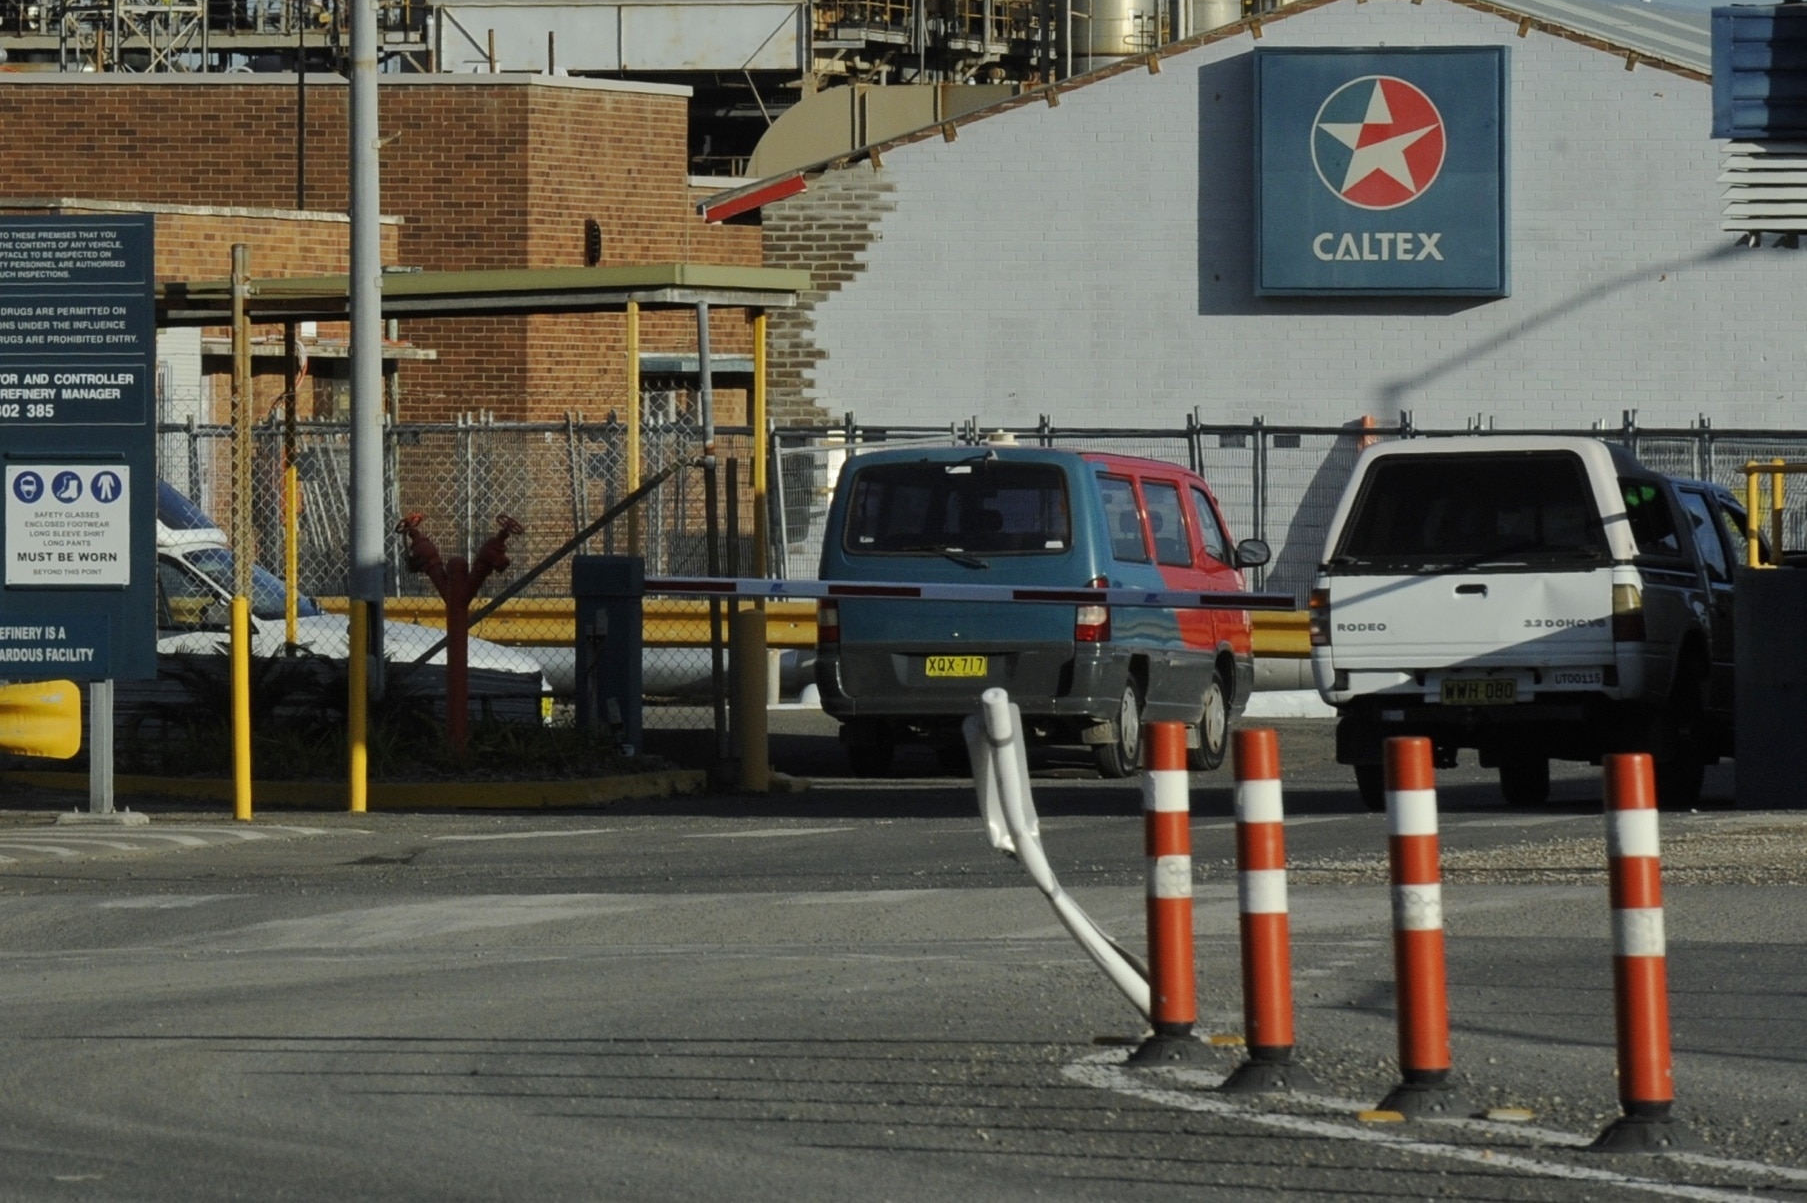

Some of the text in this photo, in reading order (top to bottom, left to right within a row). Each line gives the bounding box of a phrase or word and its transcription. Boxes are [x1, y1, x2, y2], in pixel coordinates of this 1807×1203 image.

[1313, 232, 1444, 261] CALTEX
[0, 307, 33, 315] DRUGS
[35, 307, 54, 315] ARE
[57, 307, 109, 315] PERMITTED
[112, 307, 126, 315] ON
[17, 321, 49, 330] UNDER
[53, 321, 70, 329] THE
[73, 321, 125, 329] INFLUENCE
[26, 335, 44, 344] ARE
[47, 335, 103, 344] PROHIBITED
[106, 335, 138, 343] ENTRY.
[24, 374, 48, 385] AND
[54, 374, 134, 385] CONTROLLER
[0, 389, 55, 400] REFINERY
[61, 388, 120, 399] MANAGER
[27, 405, 54, 417] 385
[17, 552, 117, 562] MUST BE WORN
[1338, 623, 1387, 631] RODEO
[45, 627, 56, 639] IS
[58, 627, 66, 639] A
[46, 648, 94, 661] FACILITY
